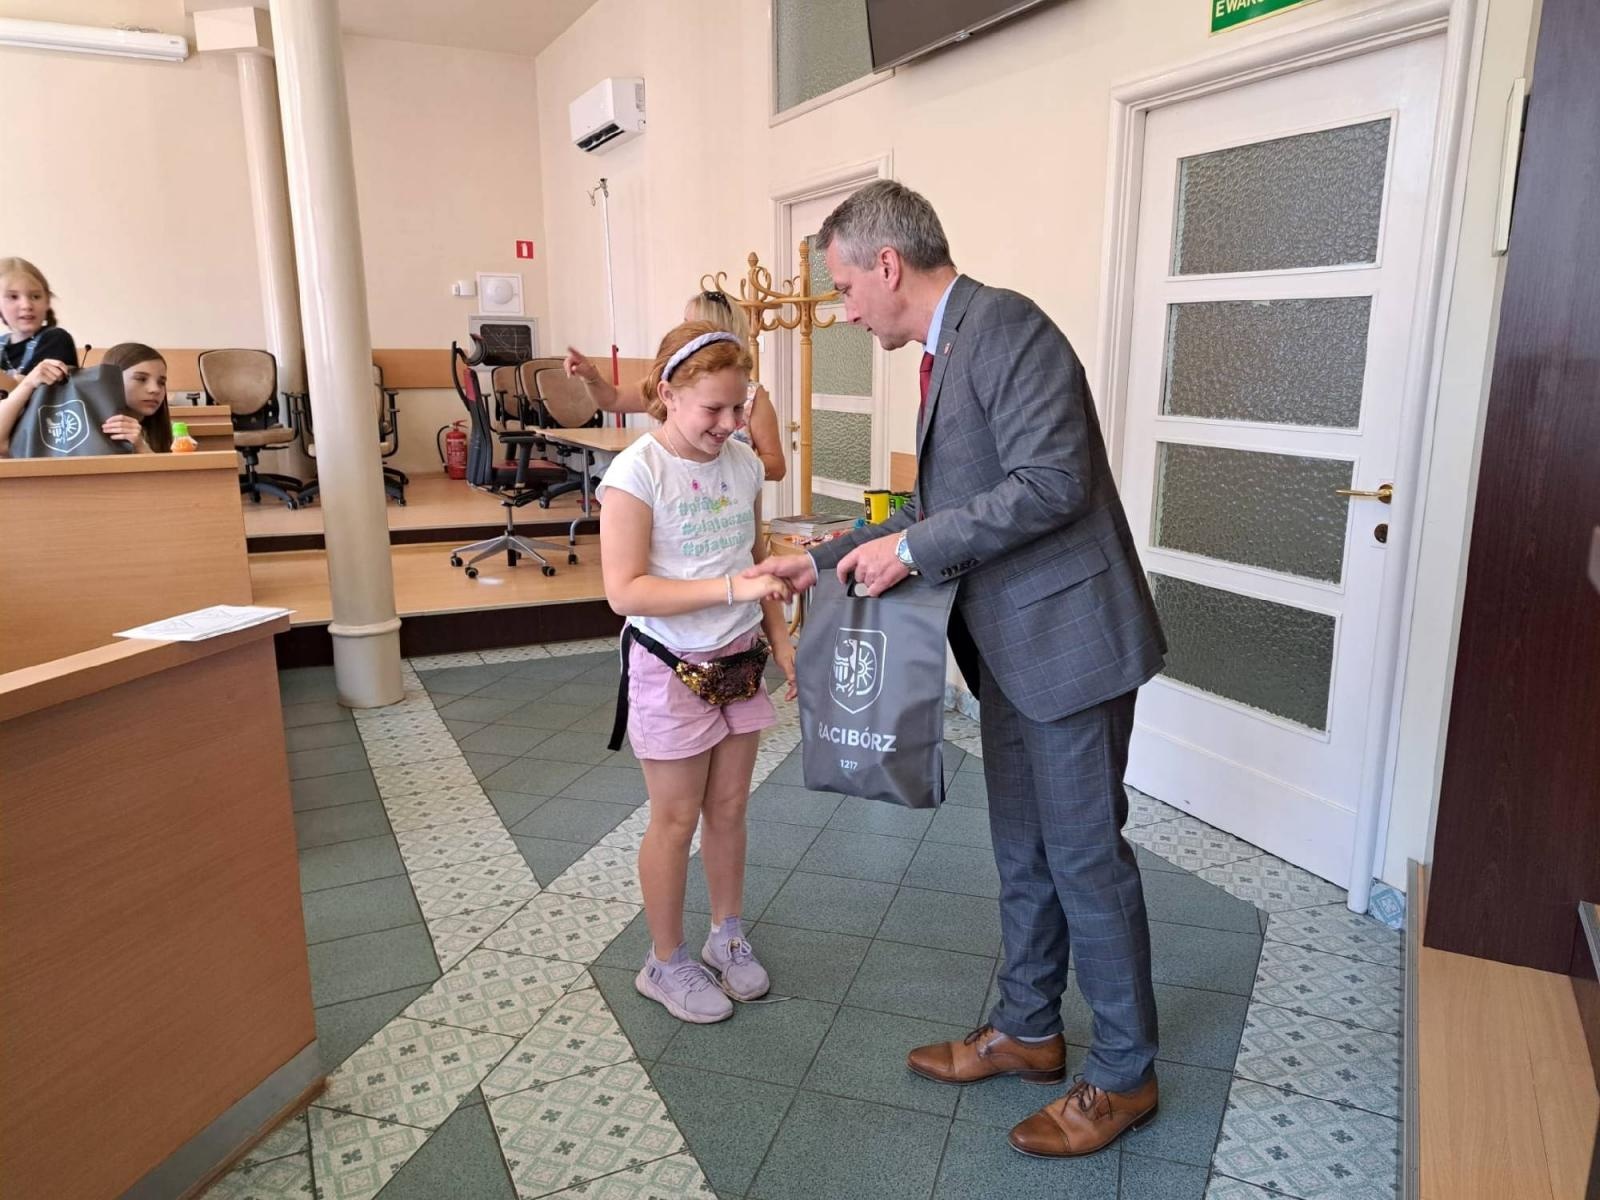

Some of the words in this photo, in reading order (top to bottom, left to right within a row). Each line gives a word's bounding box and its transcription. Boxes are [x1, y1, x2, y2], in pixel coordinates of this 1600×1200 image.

[1215, 0, 1264, 17] EWA
[818, 721, 897, 752] RACIBÓRZ
[840, 759, 858, 770] 1217
